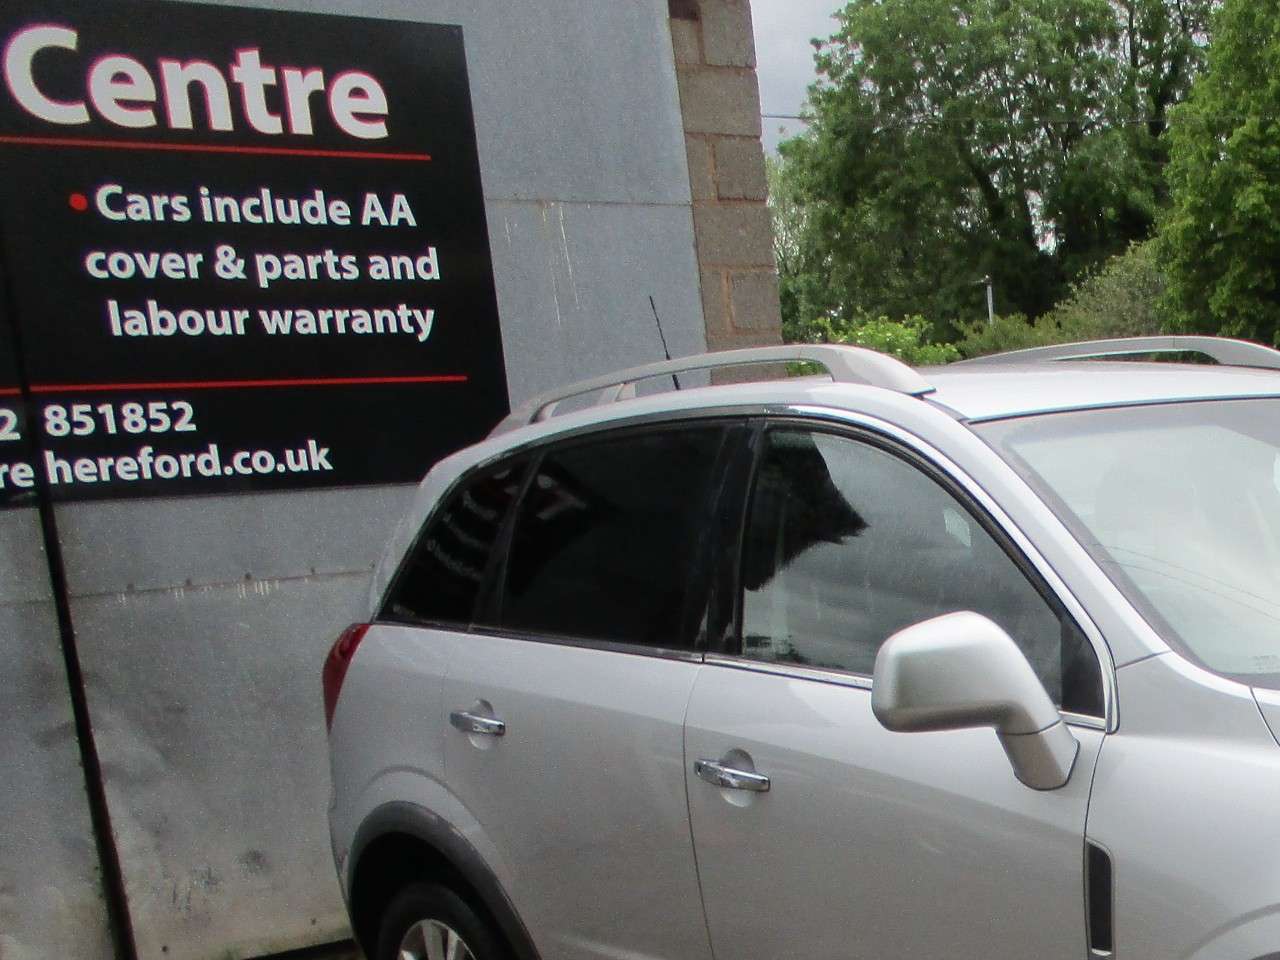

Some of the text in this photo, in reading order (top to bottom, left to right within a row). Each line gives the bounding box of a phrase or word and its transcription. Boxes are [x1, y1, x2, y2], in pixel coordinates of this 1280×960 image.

[4, 24, 390, 140] Centre
[95, 184, 417, 227] Cars include AA
[86, 244, 441, 289] cover & parts and
[107, 299, 436, 342] labour warranty
[44, 400, 197, 437] 851852
